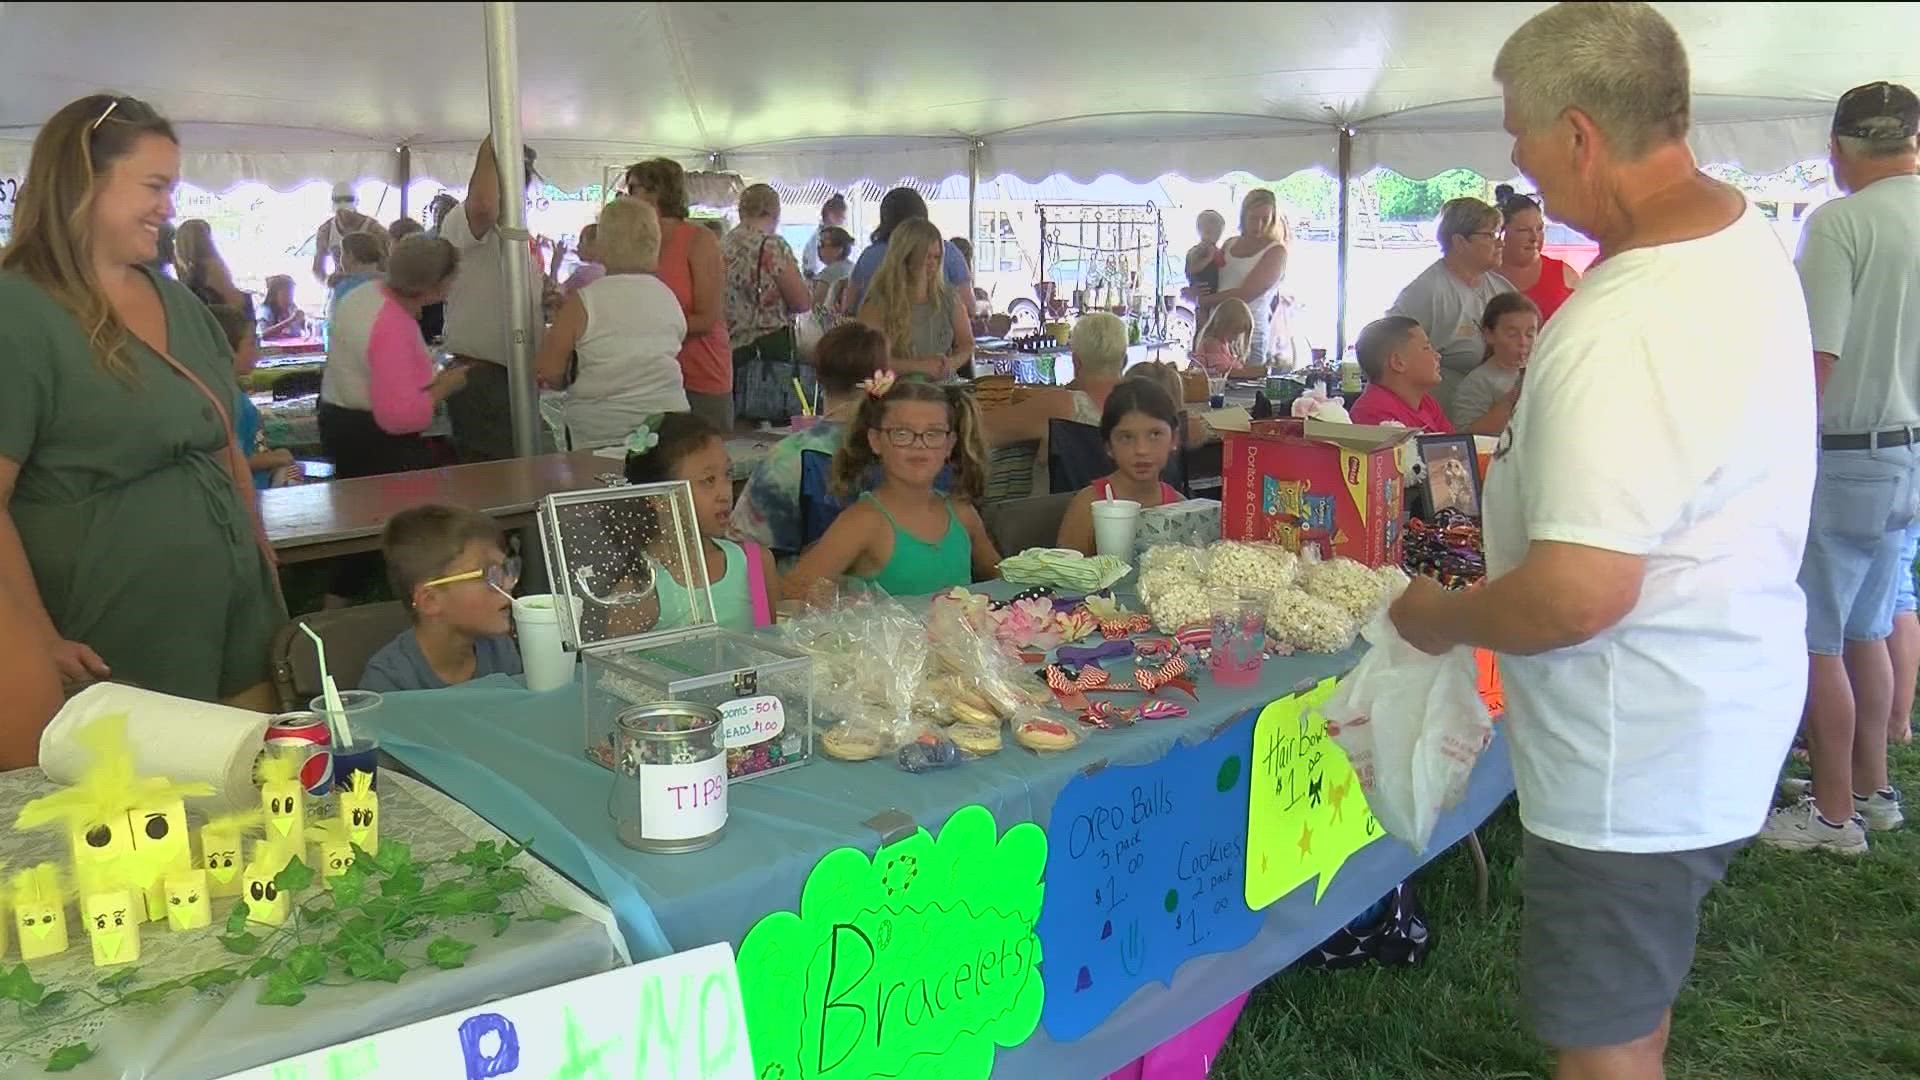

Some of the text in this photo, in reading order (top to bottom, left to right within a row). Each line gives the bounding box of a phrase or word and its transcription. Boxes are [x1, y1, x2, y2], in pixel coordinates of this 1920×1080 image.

[1244, 446, 1258, 539] Doritos & Cheet
[724, 725, 751, 738] EADS
[1262, 727, 1296, 777] Hair
[667, 775, 723, 810] TIPS
[1069, 777, 1173, 860] Oreo Balls
[1097, 830, 1142, 869] 3 pack
[1177, 835, 1241, 881] Cookies
[1192, 869, 1233, 900] 2 pack
[817, 922, 1035, 1075] Bracelets
